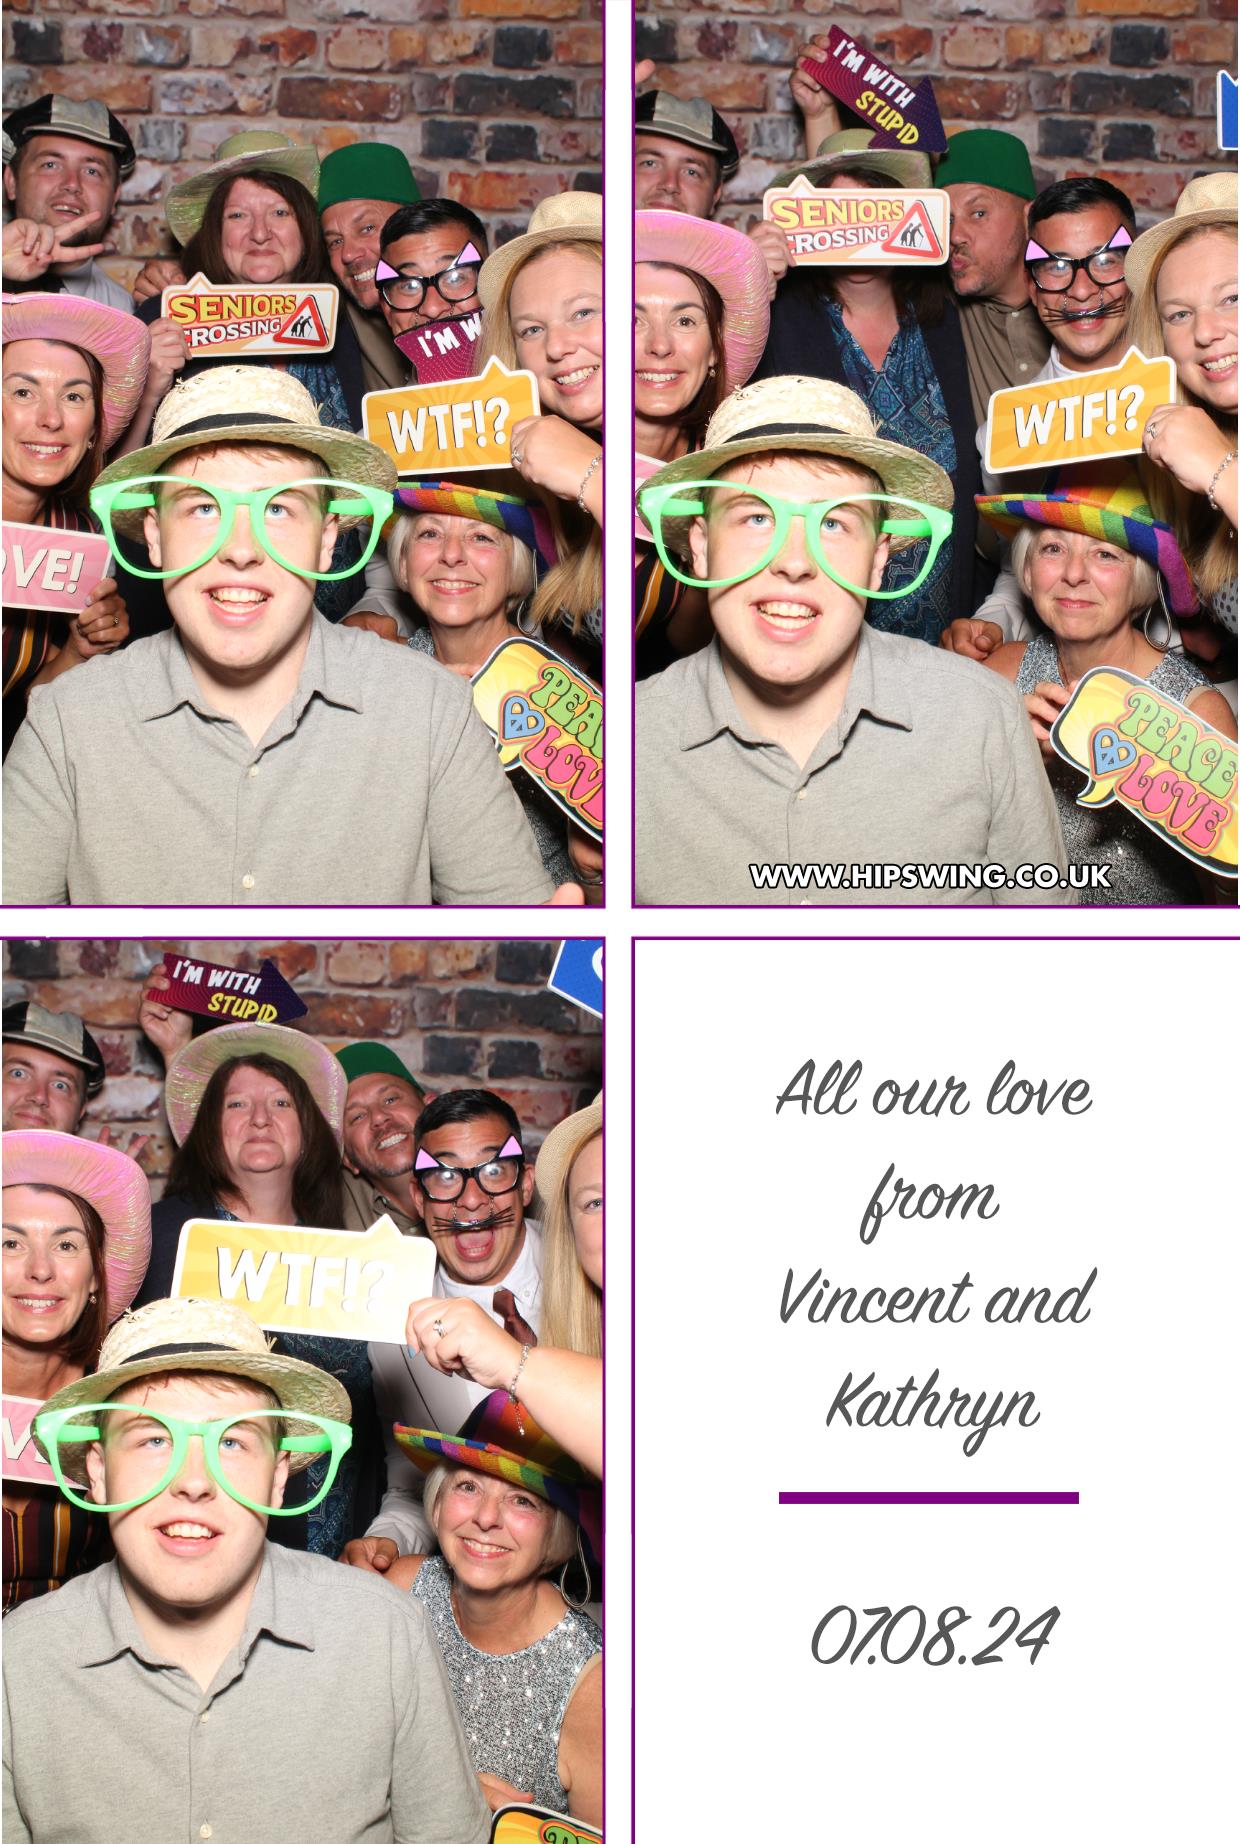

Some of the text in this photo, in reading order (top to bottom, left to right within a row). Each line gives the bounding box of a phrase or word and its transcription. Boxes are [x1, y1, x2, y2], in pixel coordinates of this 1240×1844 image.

[832, 39, 916, 109] I'M WITH
[855, 90, 920, 145] STUPID
[770, 197, 905, 229] SENIORS
[169, 294, 298, 325] SENIORS
[417, 326, 461, 358] I'M
[386, 396, 511, 455] WTF!?
[1013, 384, 1146, 449] WTF!?
[2, 544, 85, 594] VE!
[529, 666, 604, 759] PEA
[1118, 692, 1239, 799] PEACE
[1118, 753, 1229, 849] LOVE
[172, 959, 262, 995] I'M WITH
[207, 992, 278, 1024] STUPID
[216, 1246, 396, 1314] WTF!?
